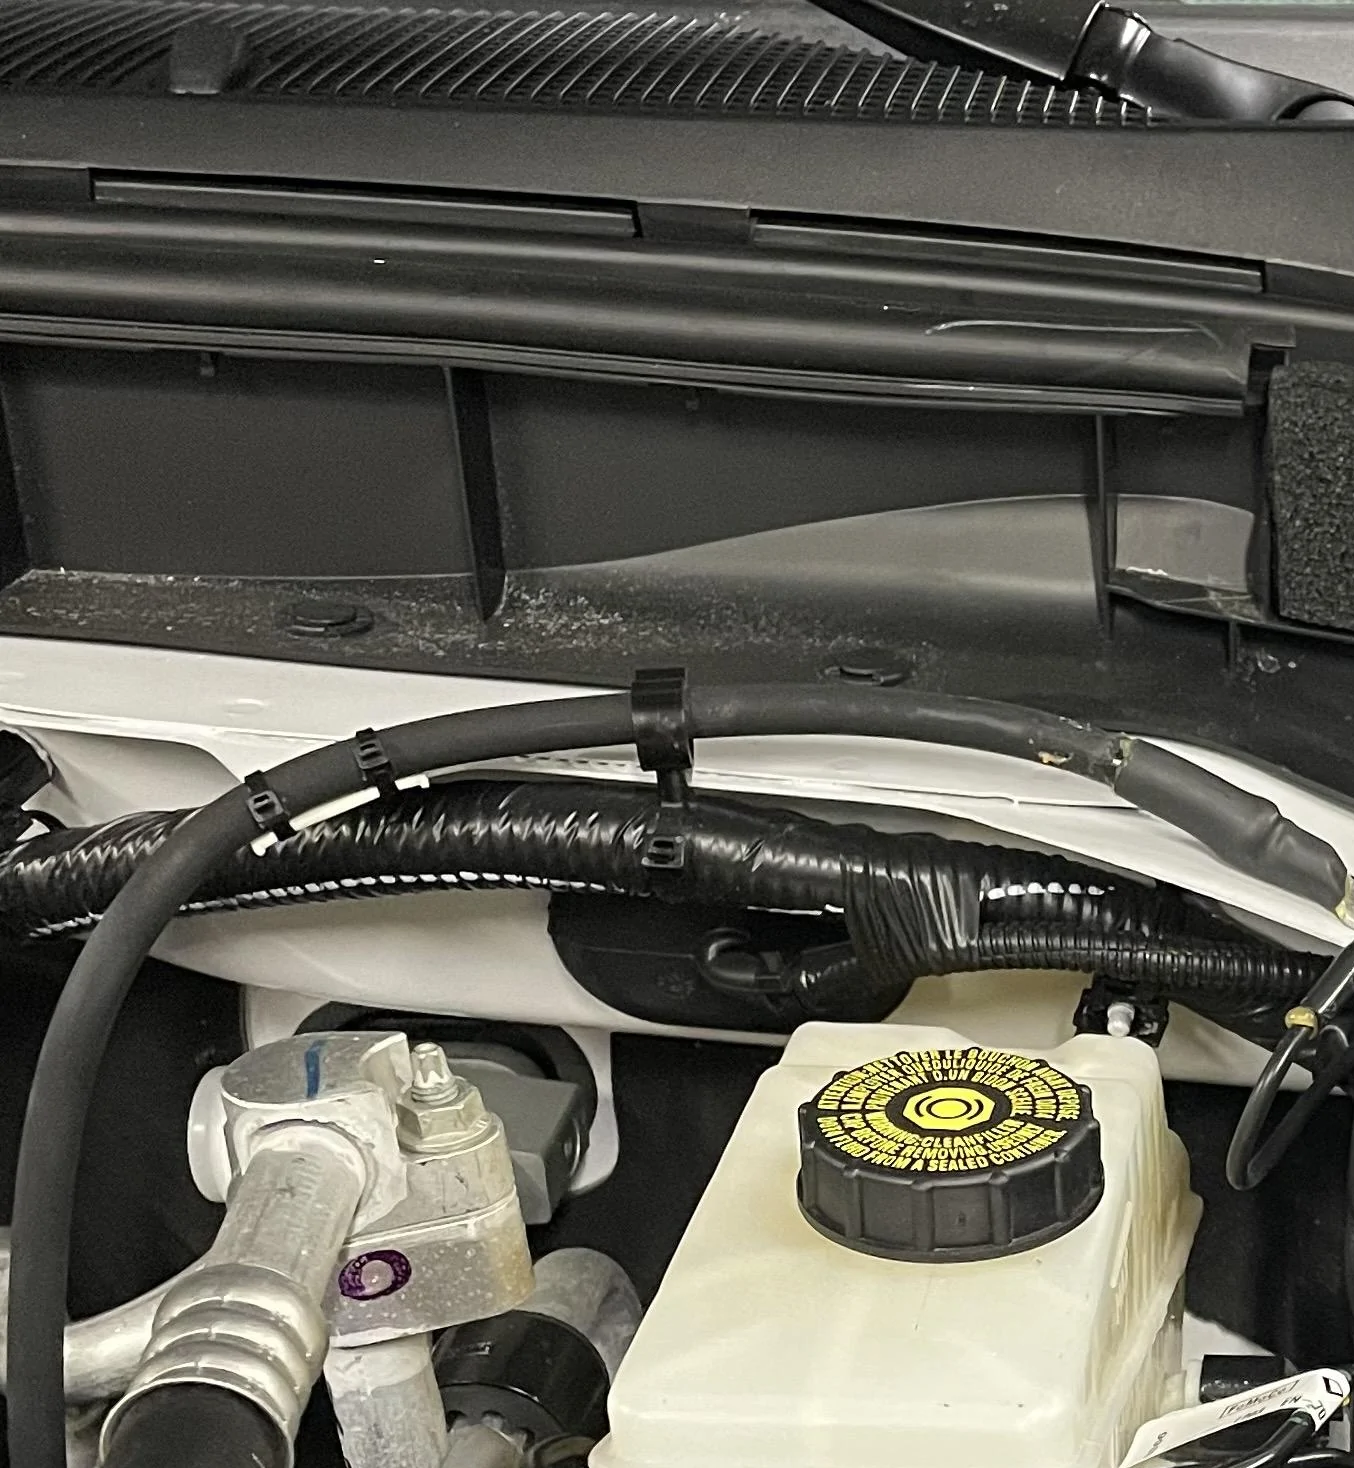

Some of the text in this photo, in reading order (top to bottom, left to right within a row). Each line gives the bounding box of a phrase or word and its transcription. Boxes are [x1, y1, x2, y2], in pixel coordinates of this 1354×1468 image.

[967, 1048, 1040, 1071] BOUCHON
[862, 1150, 911, 1170] FROM
[911, 1158, 925, 1171] A
[927, 1156, 989, 1171] SEALED
